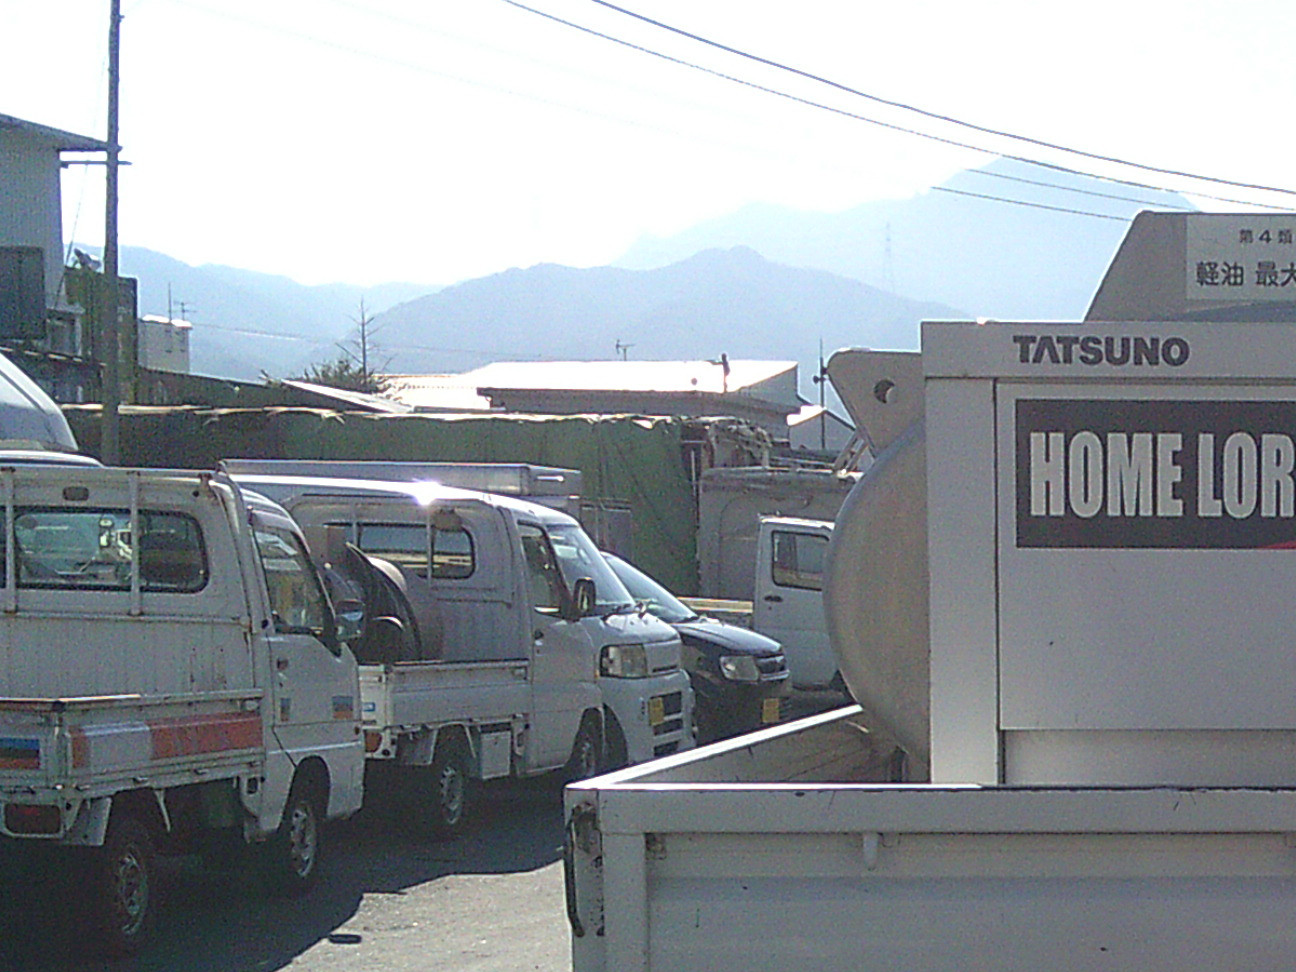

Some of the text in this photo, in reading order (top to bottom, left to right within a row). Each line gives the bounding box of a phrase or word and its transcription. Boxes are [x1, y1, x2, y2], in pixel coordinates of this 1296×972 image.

[1196, 261, 1244, 287] 軽油
[1013, 335, 1191, 367] TATSUNO
[1029, 431, 1184, 518] HOME
